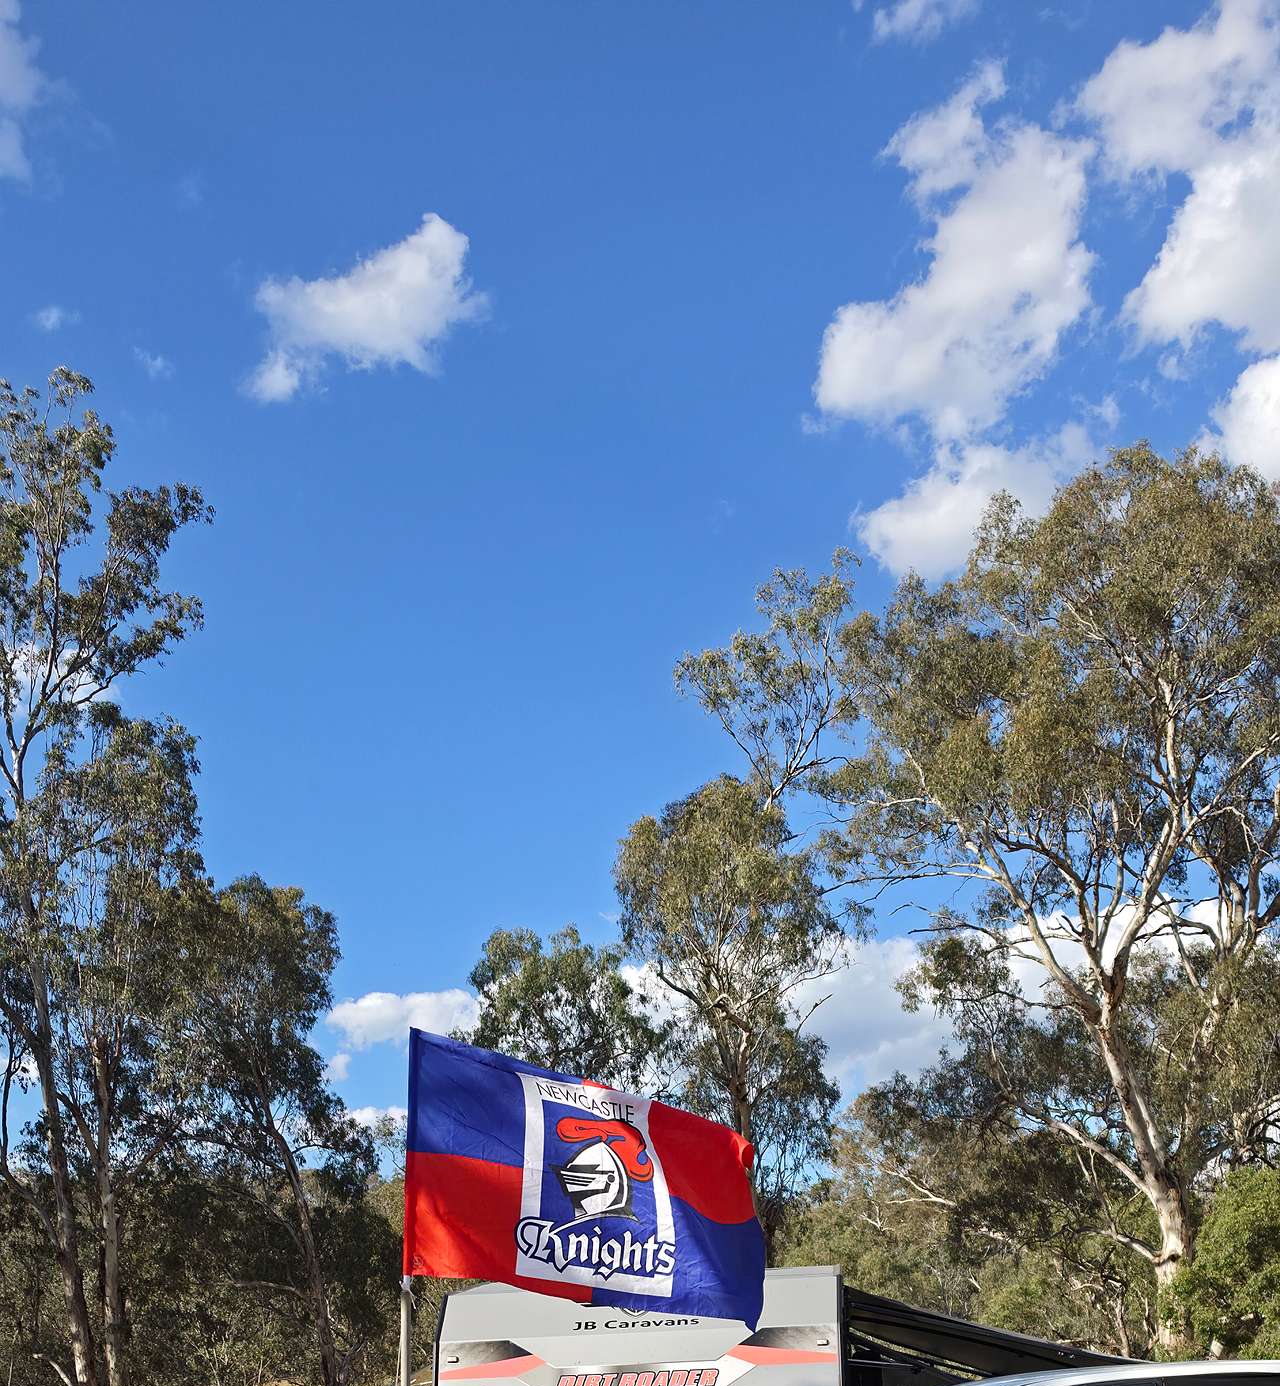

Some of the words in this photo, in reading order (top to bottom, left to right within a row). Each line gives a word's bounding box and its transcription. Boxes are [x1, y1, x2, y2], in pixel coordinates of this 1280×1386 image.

[536, 1082, 634, 1123] NEWCASTLE
[515, 1217, 676, 1280] Knights
[573, 1321, 597, 1331] JB
[604, 1318, 700, 1329] Caravans
